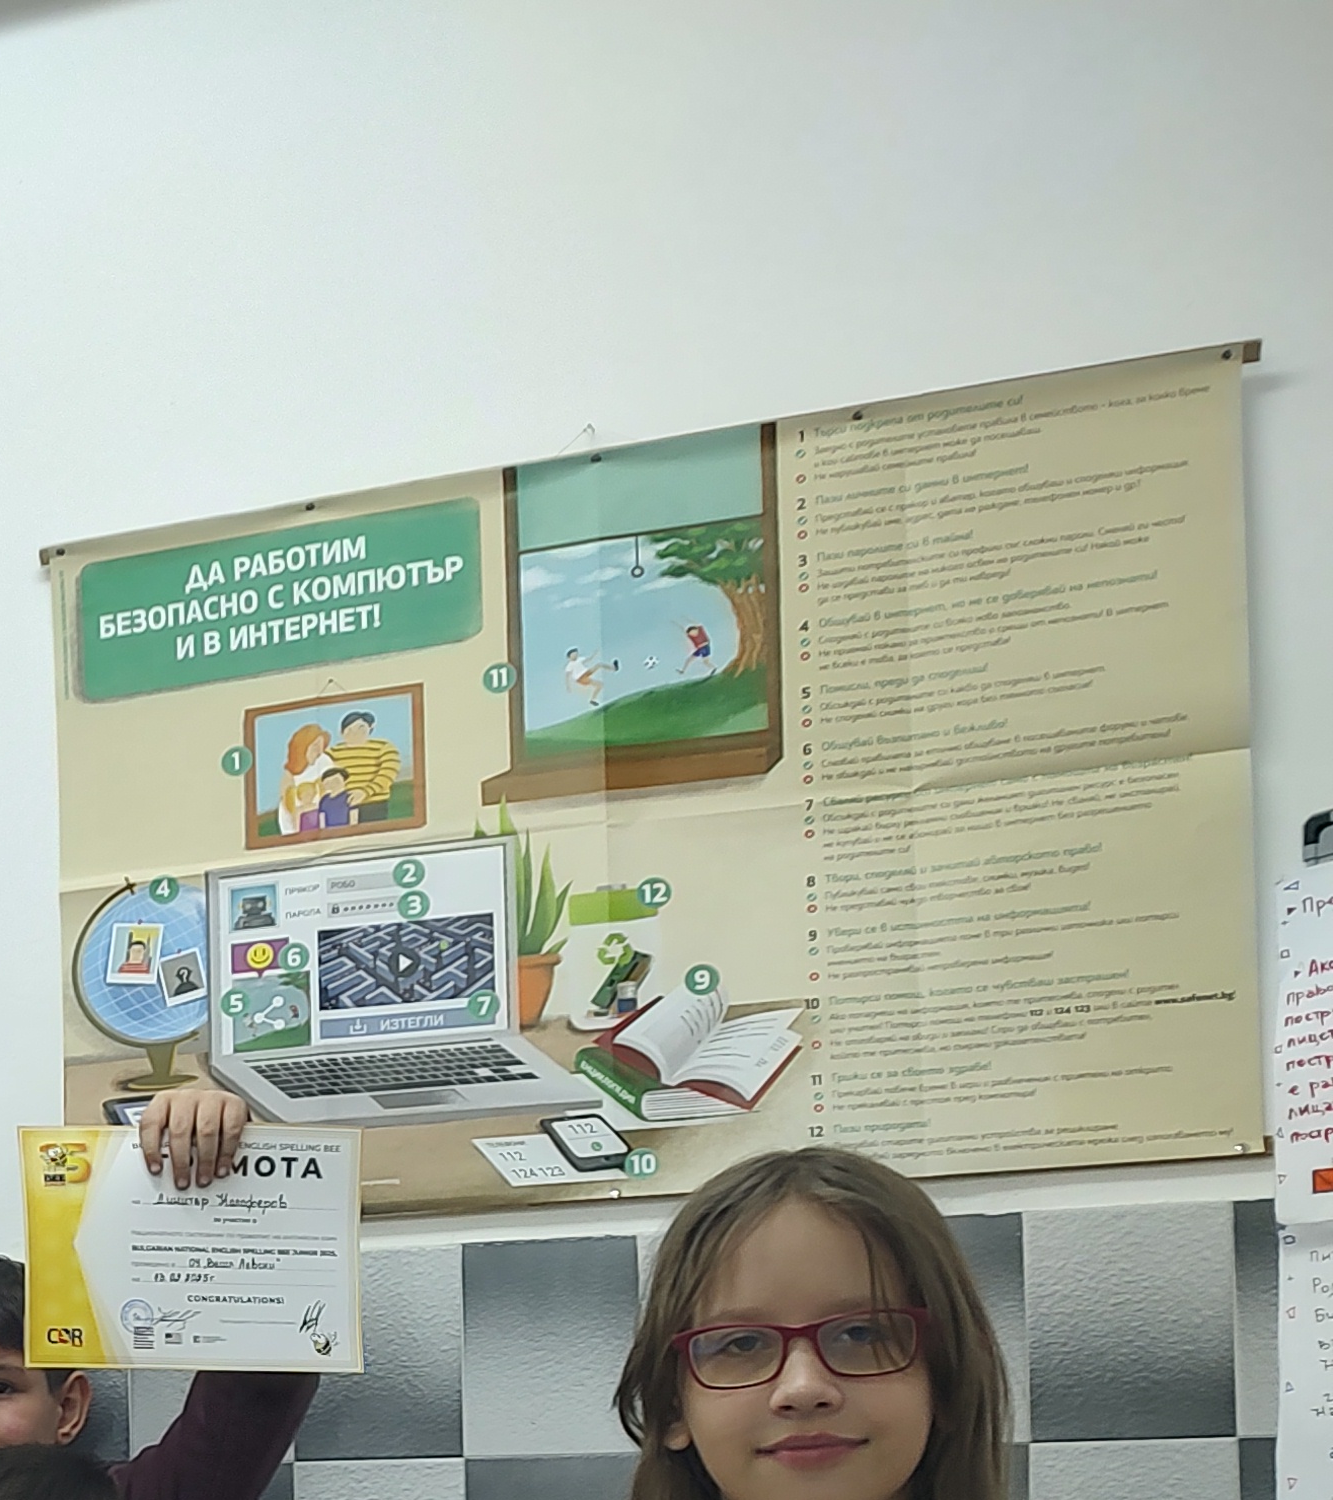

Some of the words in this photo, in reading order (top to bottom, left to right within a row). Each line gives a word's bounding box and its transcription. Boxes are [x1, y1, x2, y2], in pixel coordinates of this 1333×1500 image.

[798, 429, 806, 443] 1
[796, 497, 807, 511] 2
[185, 562, 225, 594] ДА
[233, 535, 367, 583] РАБОТИМ
[798, 553, 808, 568] 3
[98, 583, 259, 641] БЕЗОПАСНО
[267, 582, 285, 611] С
[292, 555, 464, 608] КОМПЮТЪР
[175, 633, 197, 661] И
[203, 630, 221, 657] В
[228, 604, 381, 654] ИНТЕРНЕТ!
[798, 619, 809, 633] 4
[488, 666, 511, 689] 11
[800, 686, 811, 699] 5
[802, 743, 812, 757] 6
[229, 749, 242, 772] 1
[804, 798, 814, 812] 7
[401, 863, 418, 884] 2
[155, 878, 173, 900] 4
[806, 875, 816, 888] 8
[640, 881, 669, 904] 12
[407, 895, 423, 915] 3
[808, 929, 818, 942] 9
[286, 947, 302, 967] 6
[693, 967, 711, 991] 9
[227, 993, 245, 1016] 5
[475, 995, 493, 1017] 7
[804, 997, 821, 1011] 10
[380, 1013, 445, 1032] ИЗТЕГЛИ
[810, 1073, 823, 1087] 11
[567, 1122, 599, 1135] 112
[808, 1125, 824, 1139] 12
[498, 1151, 527, 1162] 112
[630, 1153, 658, 1175] 10
[511, 1168, 536, 1179] 124
[540, 1165, 566, 1178] 123
[186, 1294, 285, 1306] CONGRATULATIONS!
